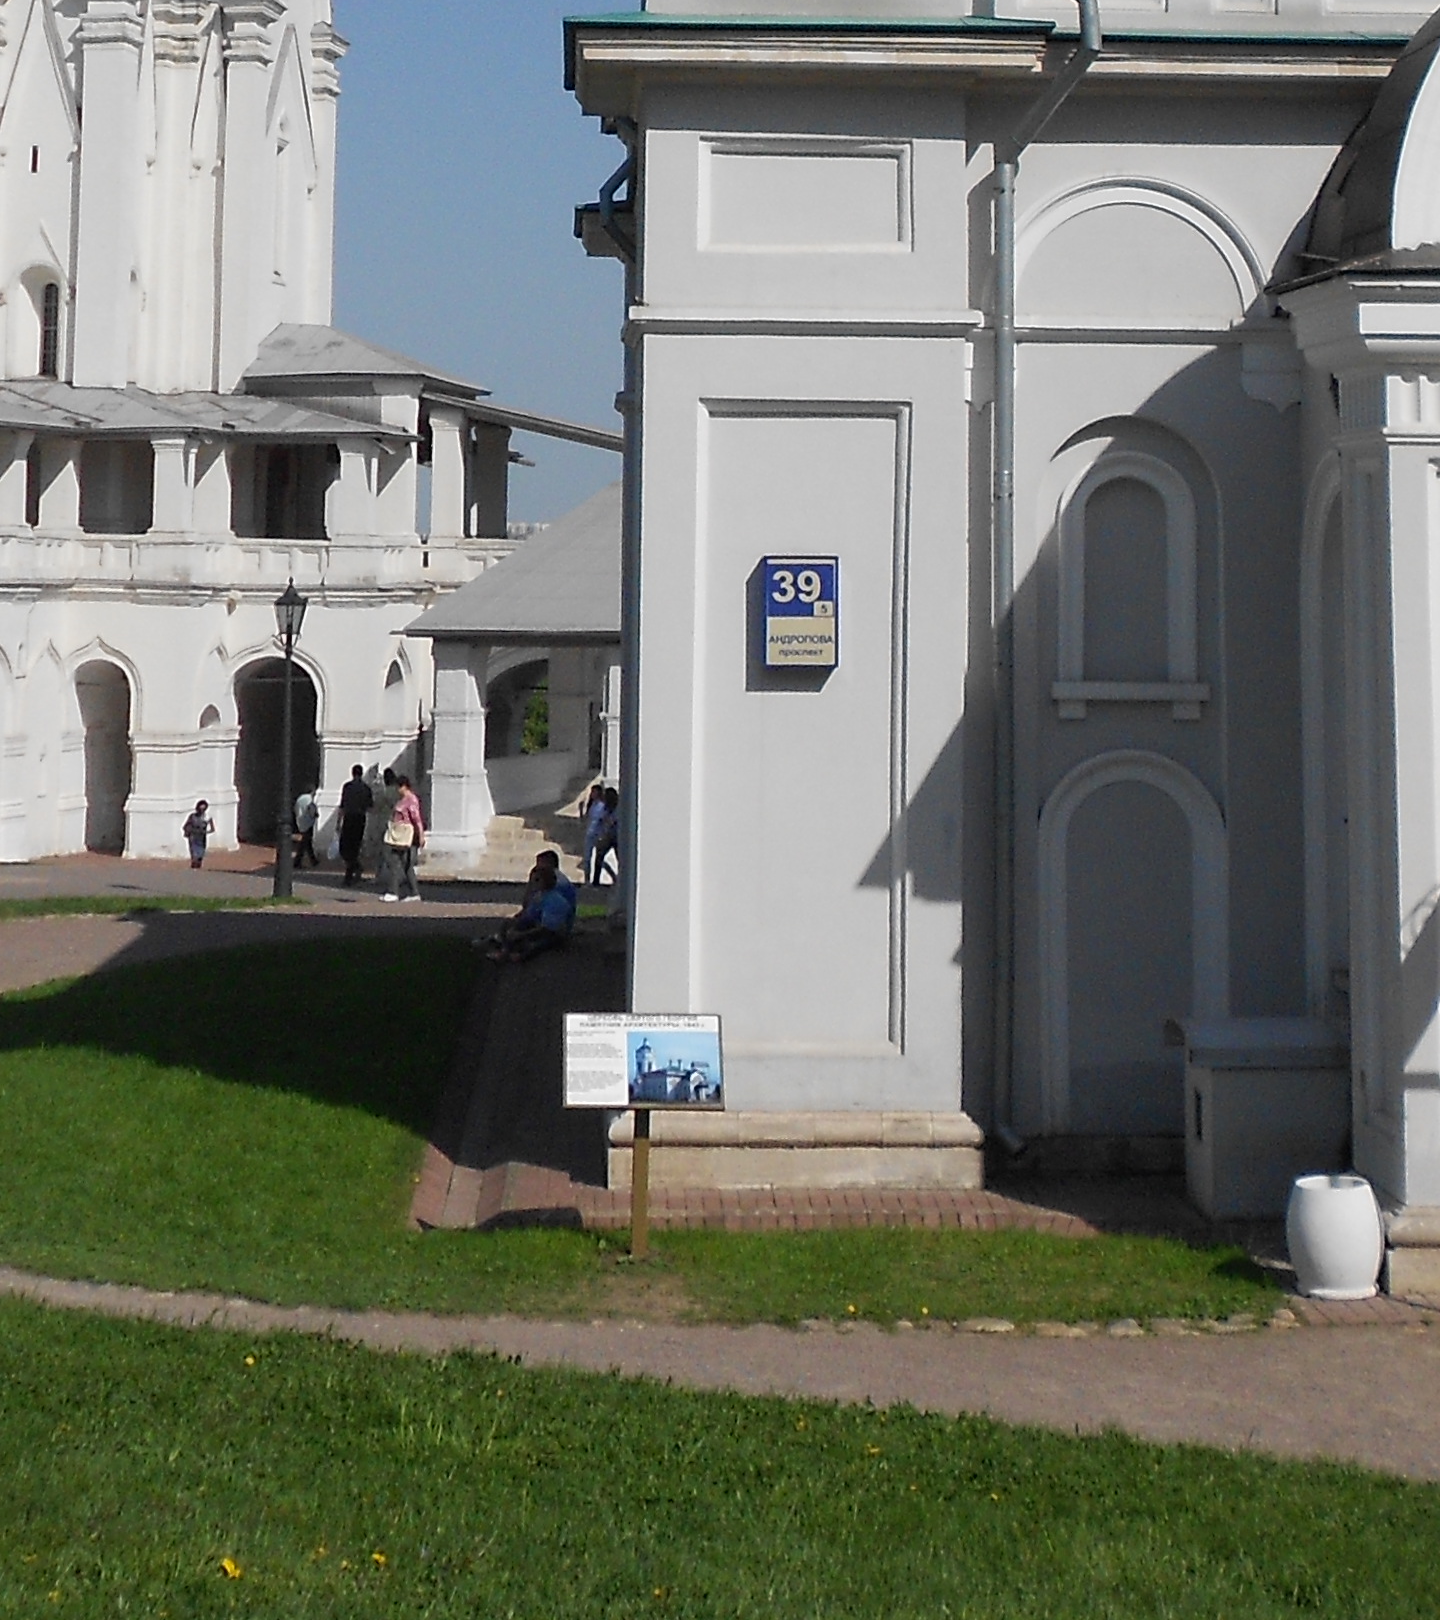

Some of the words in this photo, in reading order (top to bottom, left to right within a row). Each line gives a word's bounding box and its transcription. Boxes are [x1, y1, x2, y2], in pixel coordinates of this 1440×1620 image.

[771, 569, 821, 603] 39
[769, 635, 833, 644] АНДРОПОВА
[778, 649, 824, 657] проспект
